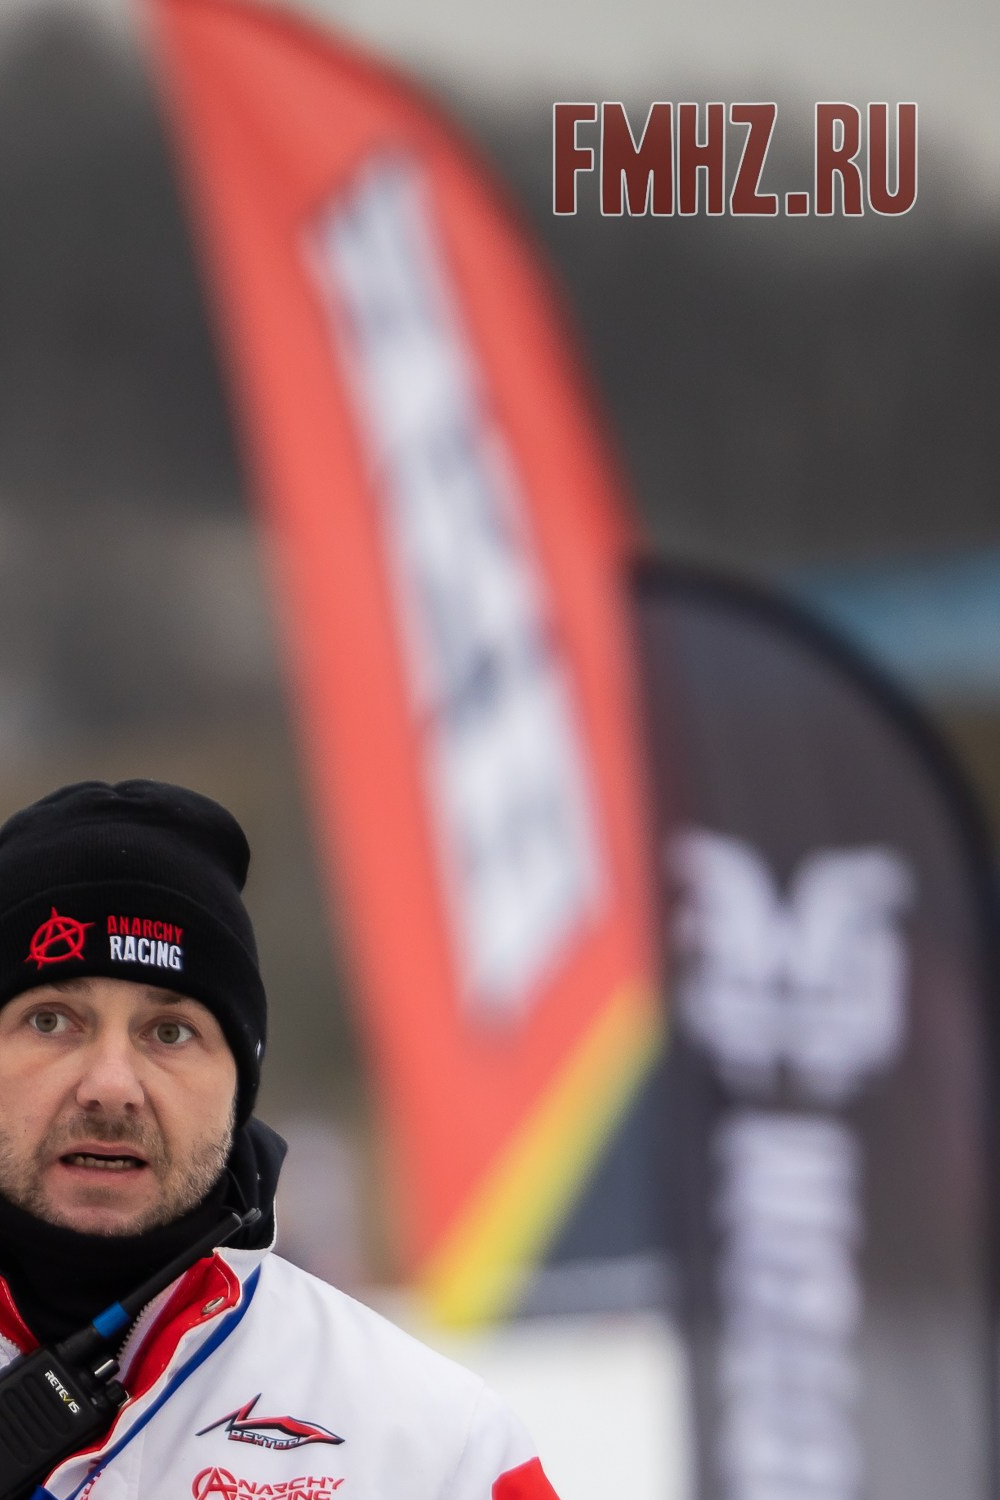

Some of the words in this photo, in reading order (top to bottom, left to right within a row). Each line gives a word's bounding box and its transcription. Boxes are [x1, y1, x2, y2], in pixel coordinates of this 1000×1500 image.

[107, 914, 185, 943] ANARCHY
[109, 935, 184, 971] RACING
[44, 1369, 81, 1414] RETEVIS
